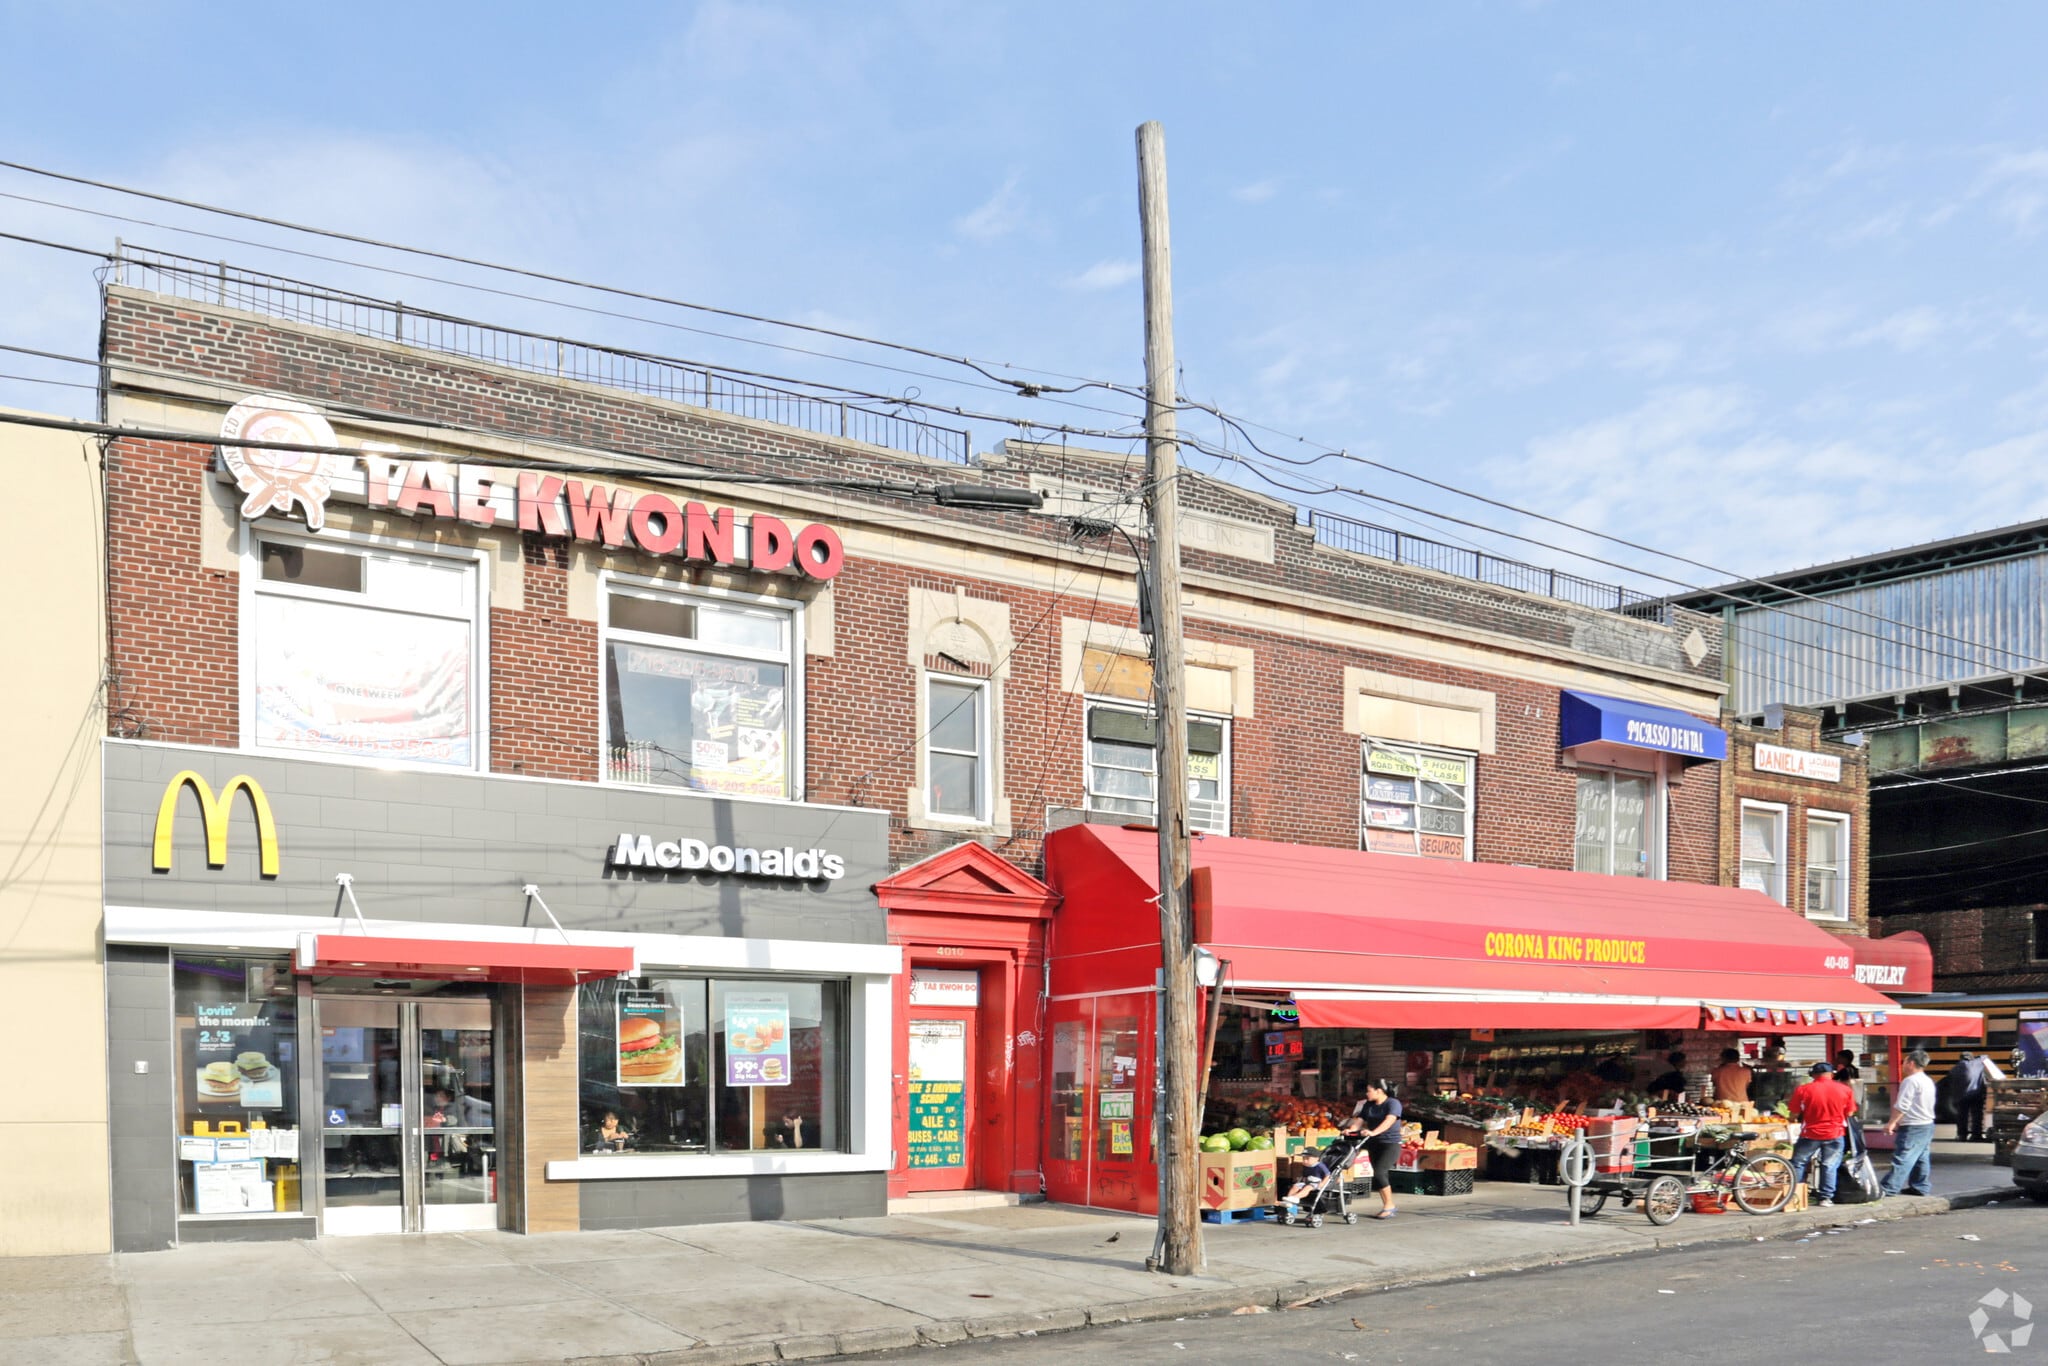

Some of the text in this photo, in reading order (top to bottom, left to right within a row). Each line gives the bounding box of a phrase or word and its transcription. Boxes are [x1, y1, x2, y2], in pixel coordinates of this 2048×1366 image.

[224, 416, 244, 471] UNED
[361, 441, 496, 525] TAE
[517, 471, 735, 565] KWON
[751, 512, 845, 580] DO
[335, 685, 363, 697] ONE
[1627, 719, 1705, 753] PICASSO DENTAL
[696, 741, 725, 755] 50%
[1371, 760, 1393, 769] ROAD
[1422, 760, 1463, 772] 5 HOUR
[1758, 749, 1805, 773] DANIELA
[1581, 787, 1644, 815] Picsso
[1420, 838, 1462, 856] SEGUROS
[614, 833, 845, 880] McDonald's
[936, 946, 965, 956] 4010
[1485, 932, 1646, 964] CORONA KING PRODUCE
[1824, 956, 1850, 970] 40-08
[923, 982, 978, 992] TAE KWON DO
[199, 1016, 220, 1027] the
[200, 1030, 210, 1042] 2
[1103, 1102, 1132, 1117] ATM
